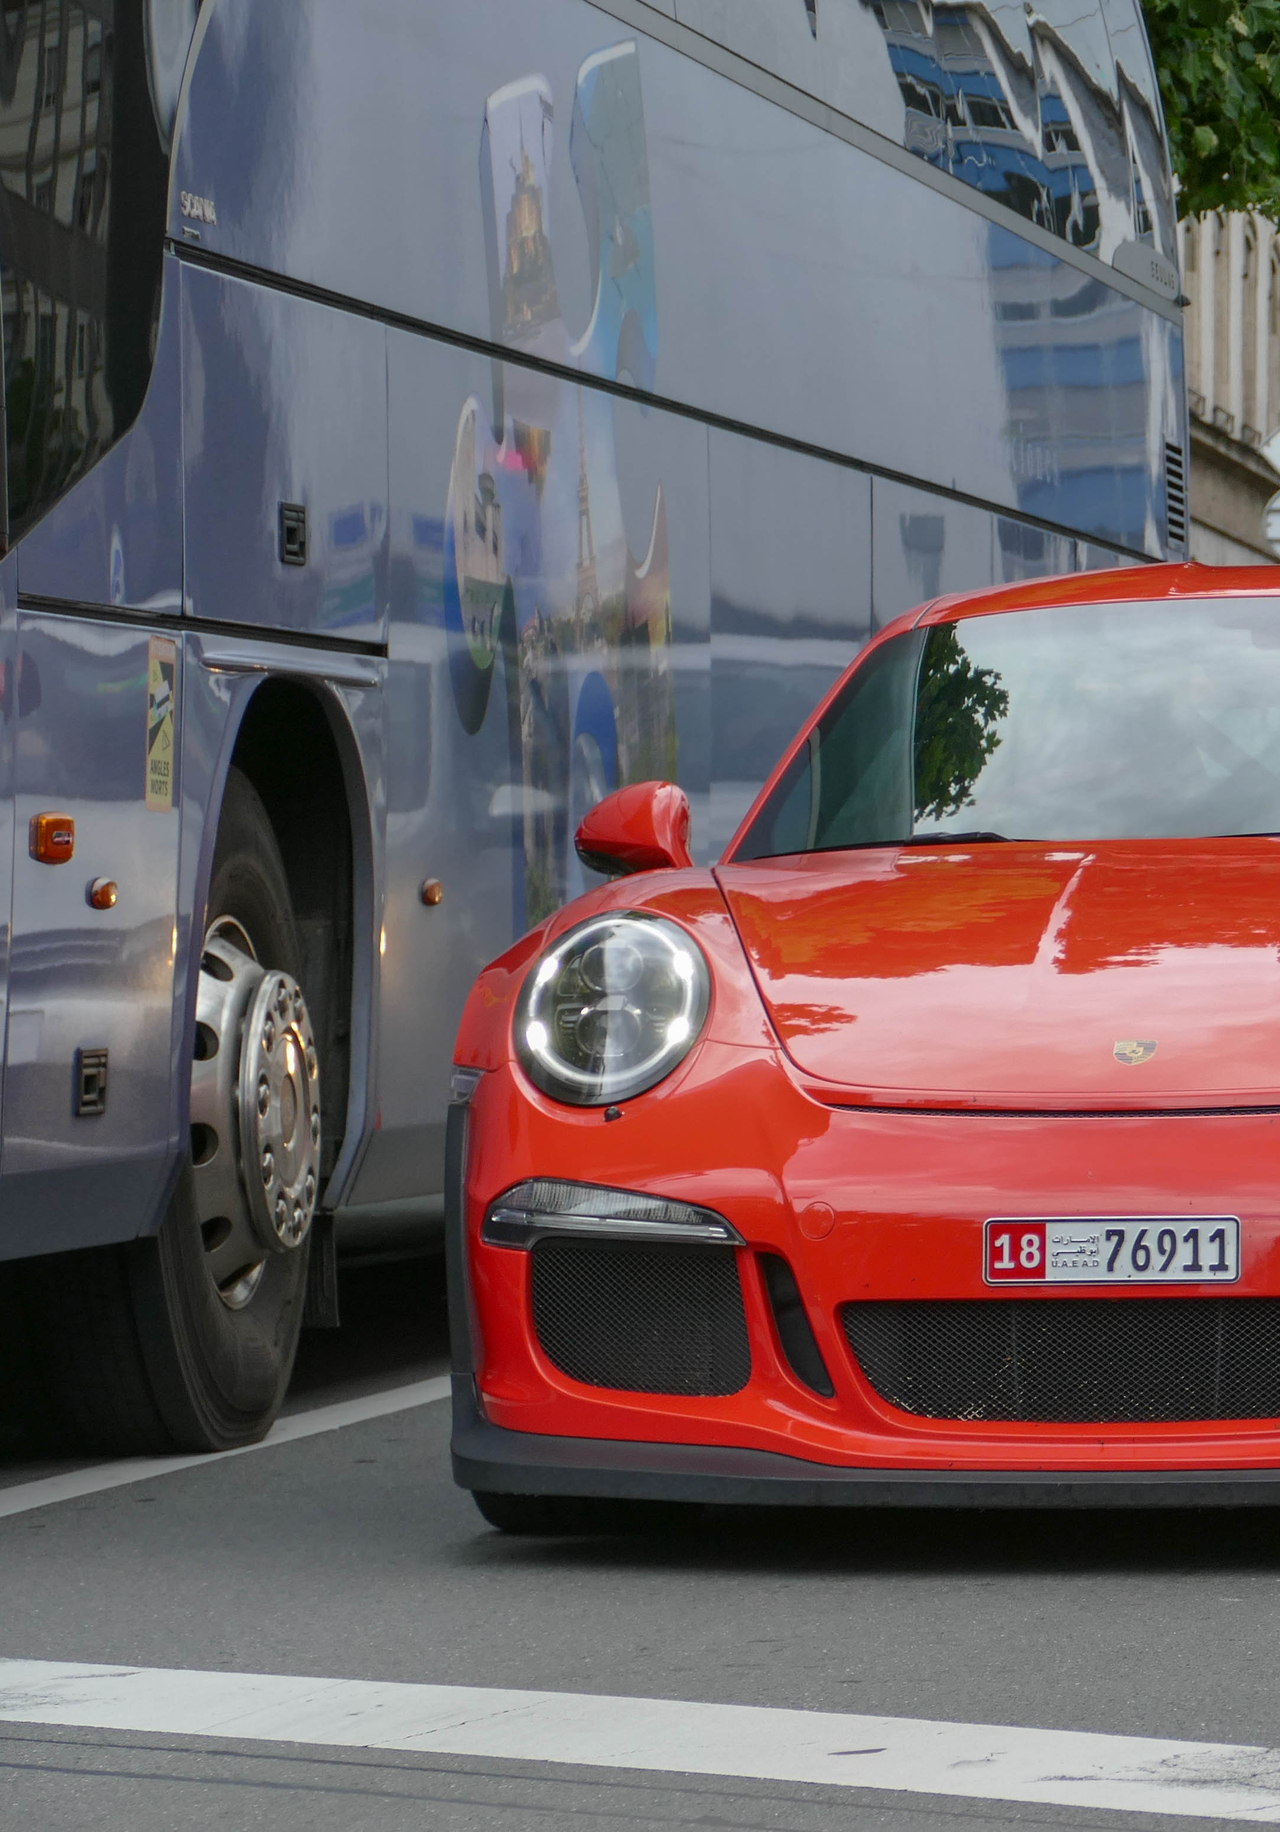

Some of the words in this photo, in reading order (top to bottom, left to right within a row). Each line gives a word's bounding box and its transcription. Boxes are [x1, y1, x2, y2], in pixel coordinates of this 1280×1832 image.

[181, 191, 217, 225] SCANIA
[150, 758, 170, 778] ANGLES
[994, 1234, 1041, 1269] 18
[1105, 1228, 1229, 1272] 76911
